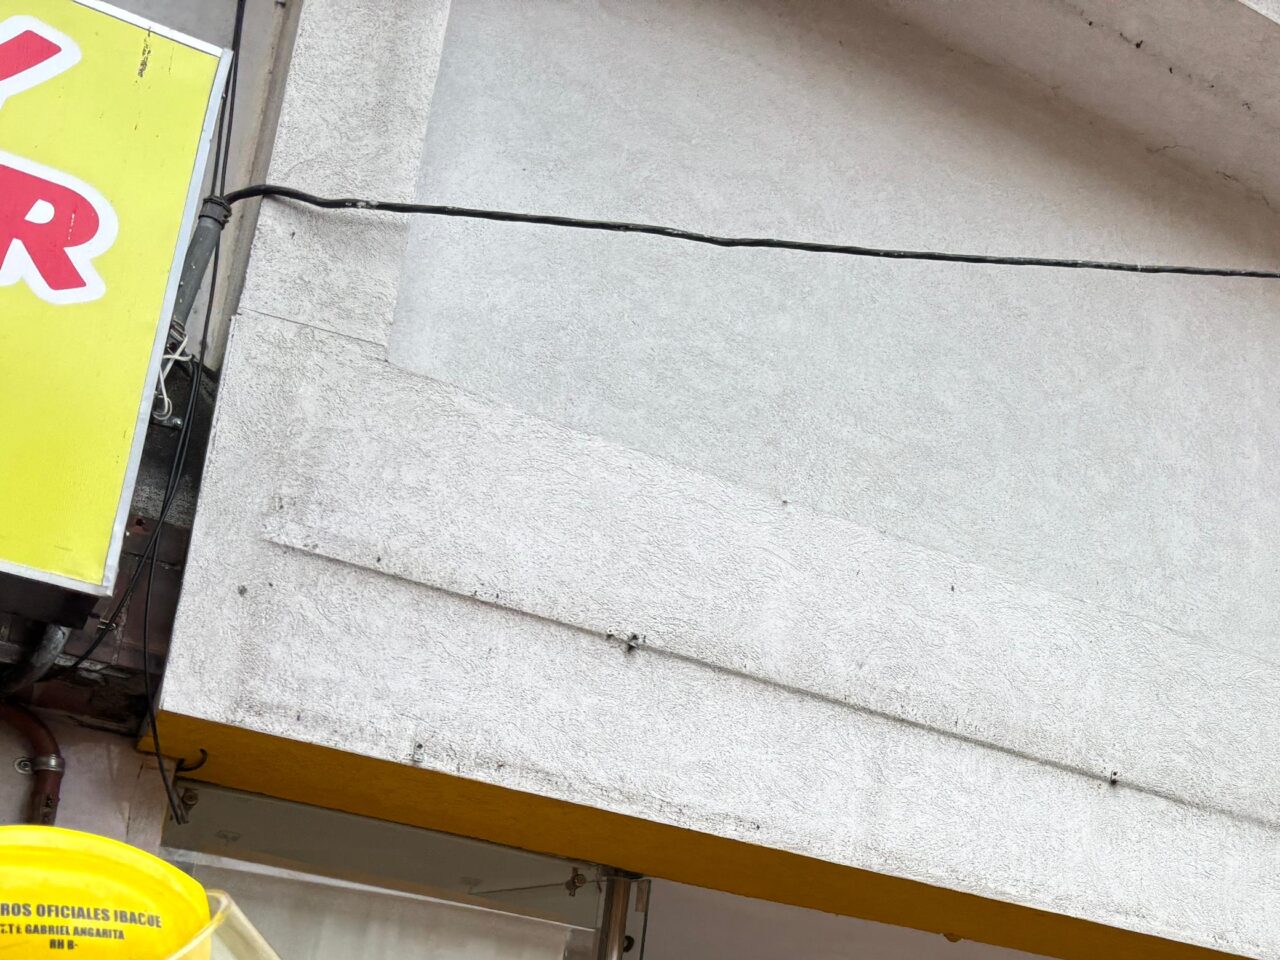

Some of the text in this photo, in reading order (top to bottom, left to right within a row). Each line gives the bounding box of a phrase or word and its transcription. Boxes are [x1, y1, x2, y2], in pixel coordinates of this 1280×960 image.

[36, 904, 110, 921] OFICIALES
[25, 924, 70, 936] GABRIEL
[73, 927, 125, 940] ANGARITA
[50, 939, 64, 949] RH
